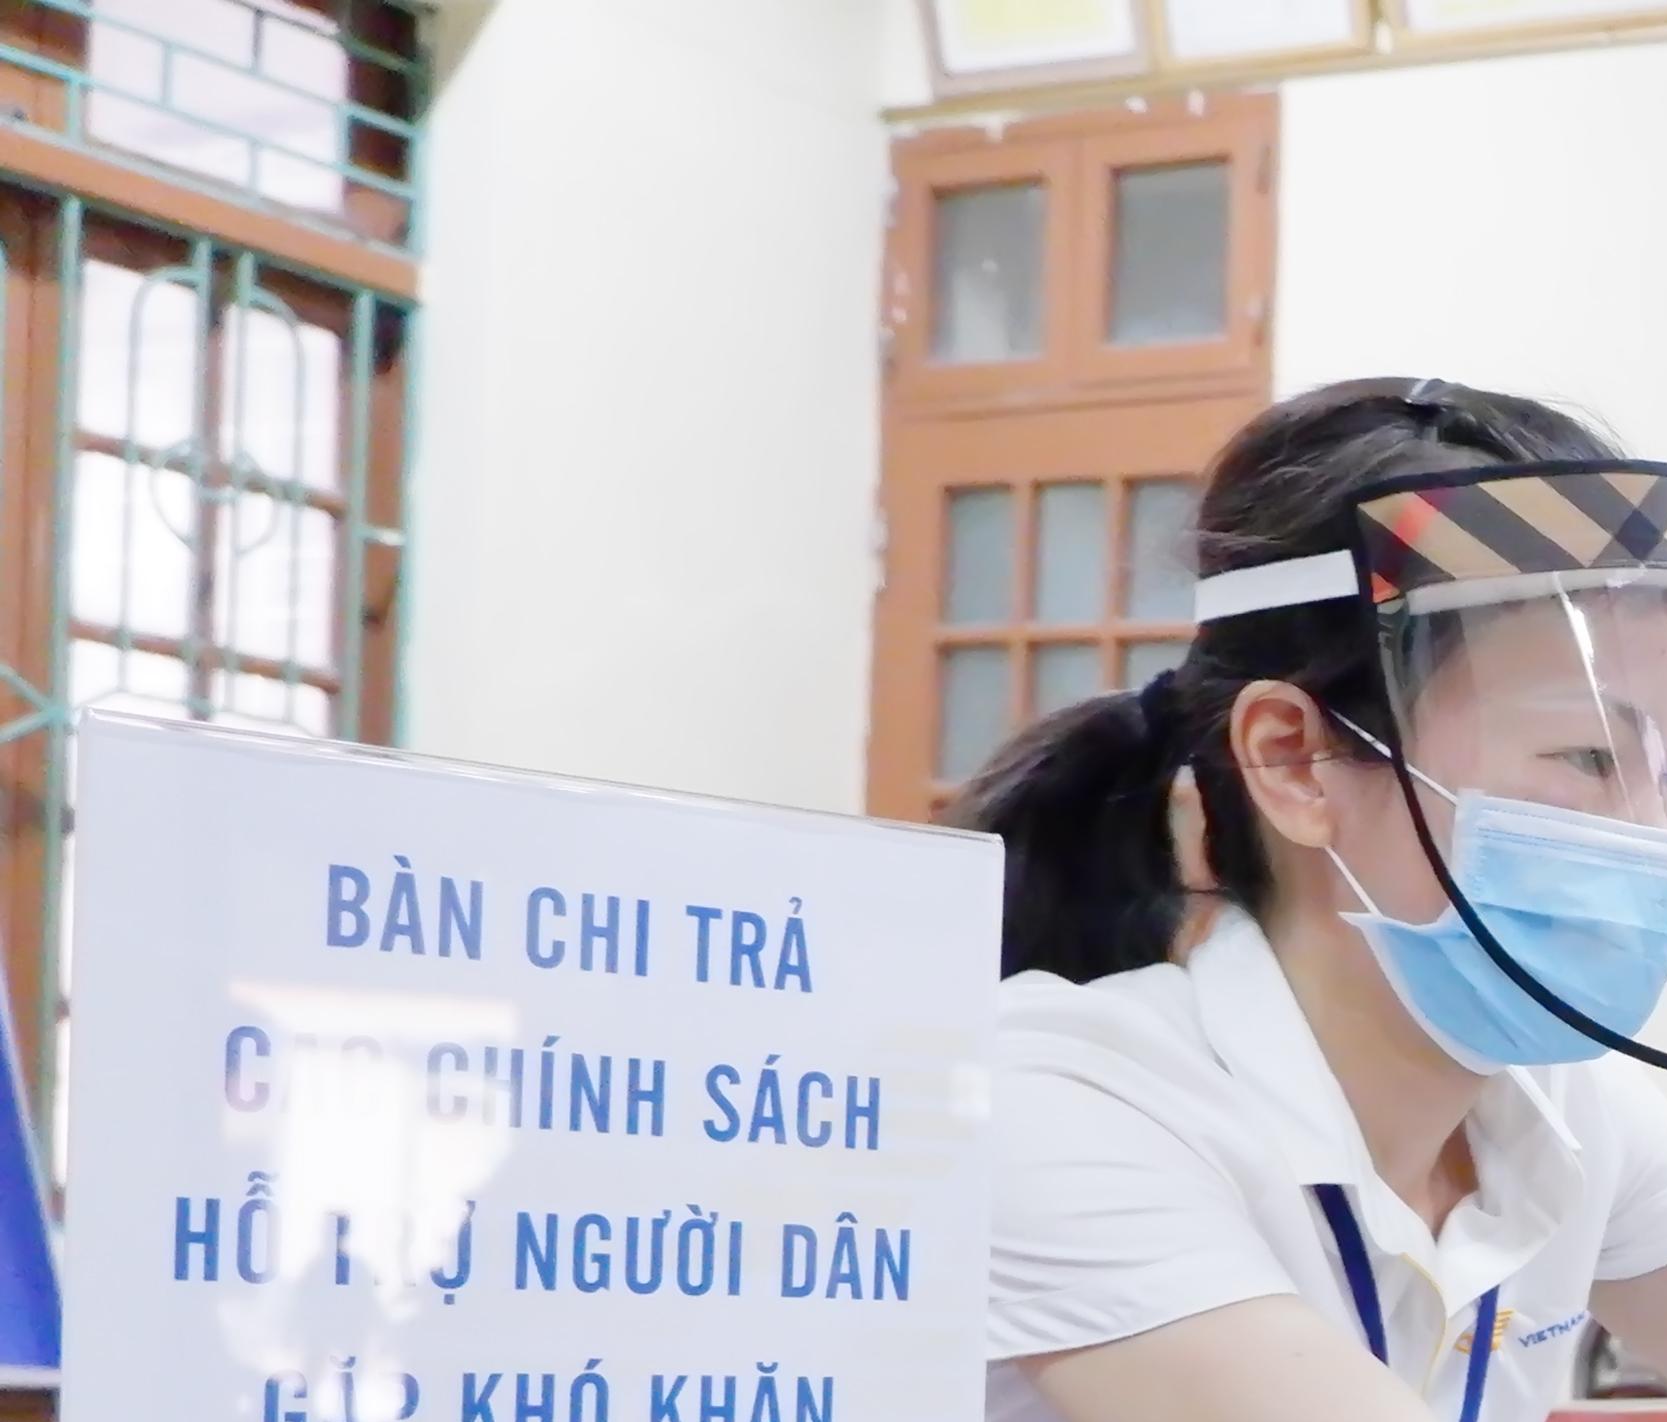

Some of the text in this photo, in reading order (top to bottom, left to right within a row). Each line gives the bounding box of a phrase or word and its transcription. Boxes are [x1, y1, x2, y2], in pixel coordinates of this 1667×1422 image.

[325, 853, 816, 994] BÀN CHI TRẢ
[425, 1034, 669, 1138] CHÍNH
[702, 1053, 881, 1151] SÁCH
[172, 1170, 279, 1285] HỖ
[514, 1202, 744, 1298] NGƯỜI
[781, 1210, 912, 1302] DÂN
